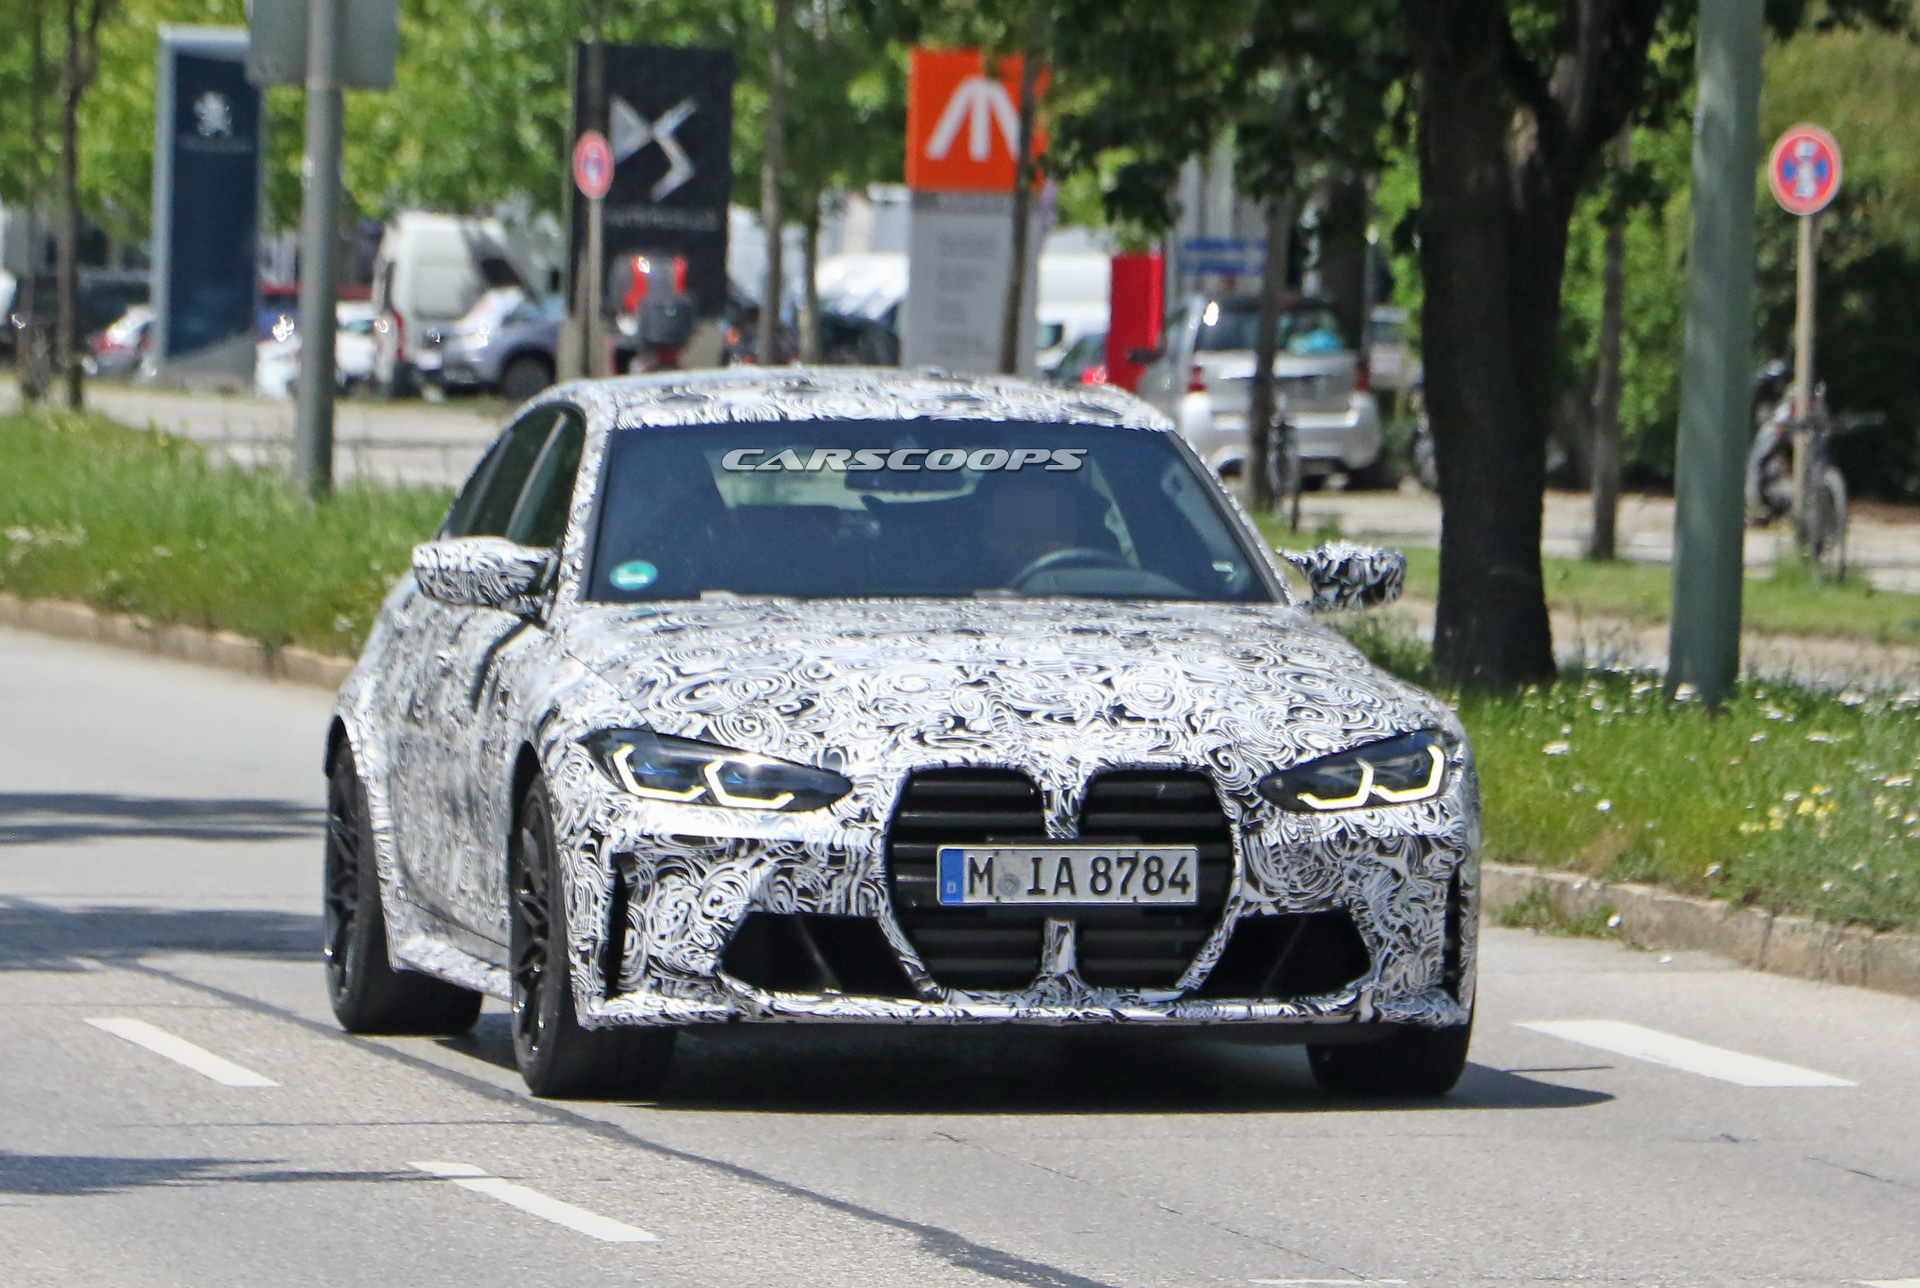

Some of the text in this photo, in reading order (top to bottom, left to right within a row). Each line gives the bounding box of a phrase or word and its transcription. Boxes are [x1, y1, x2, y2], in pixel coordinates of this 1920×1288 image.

[968, 855, 1190, 896] M IA 8784
